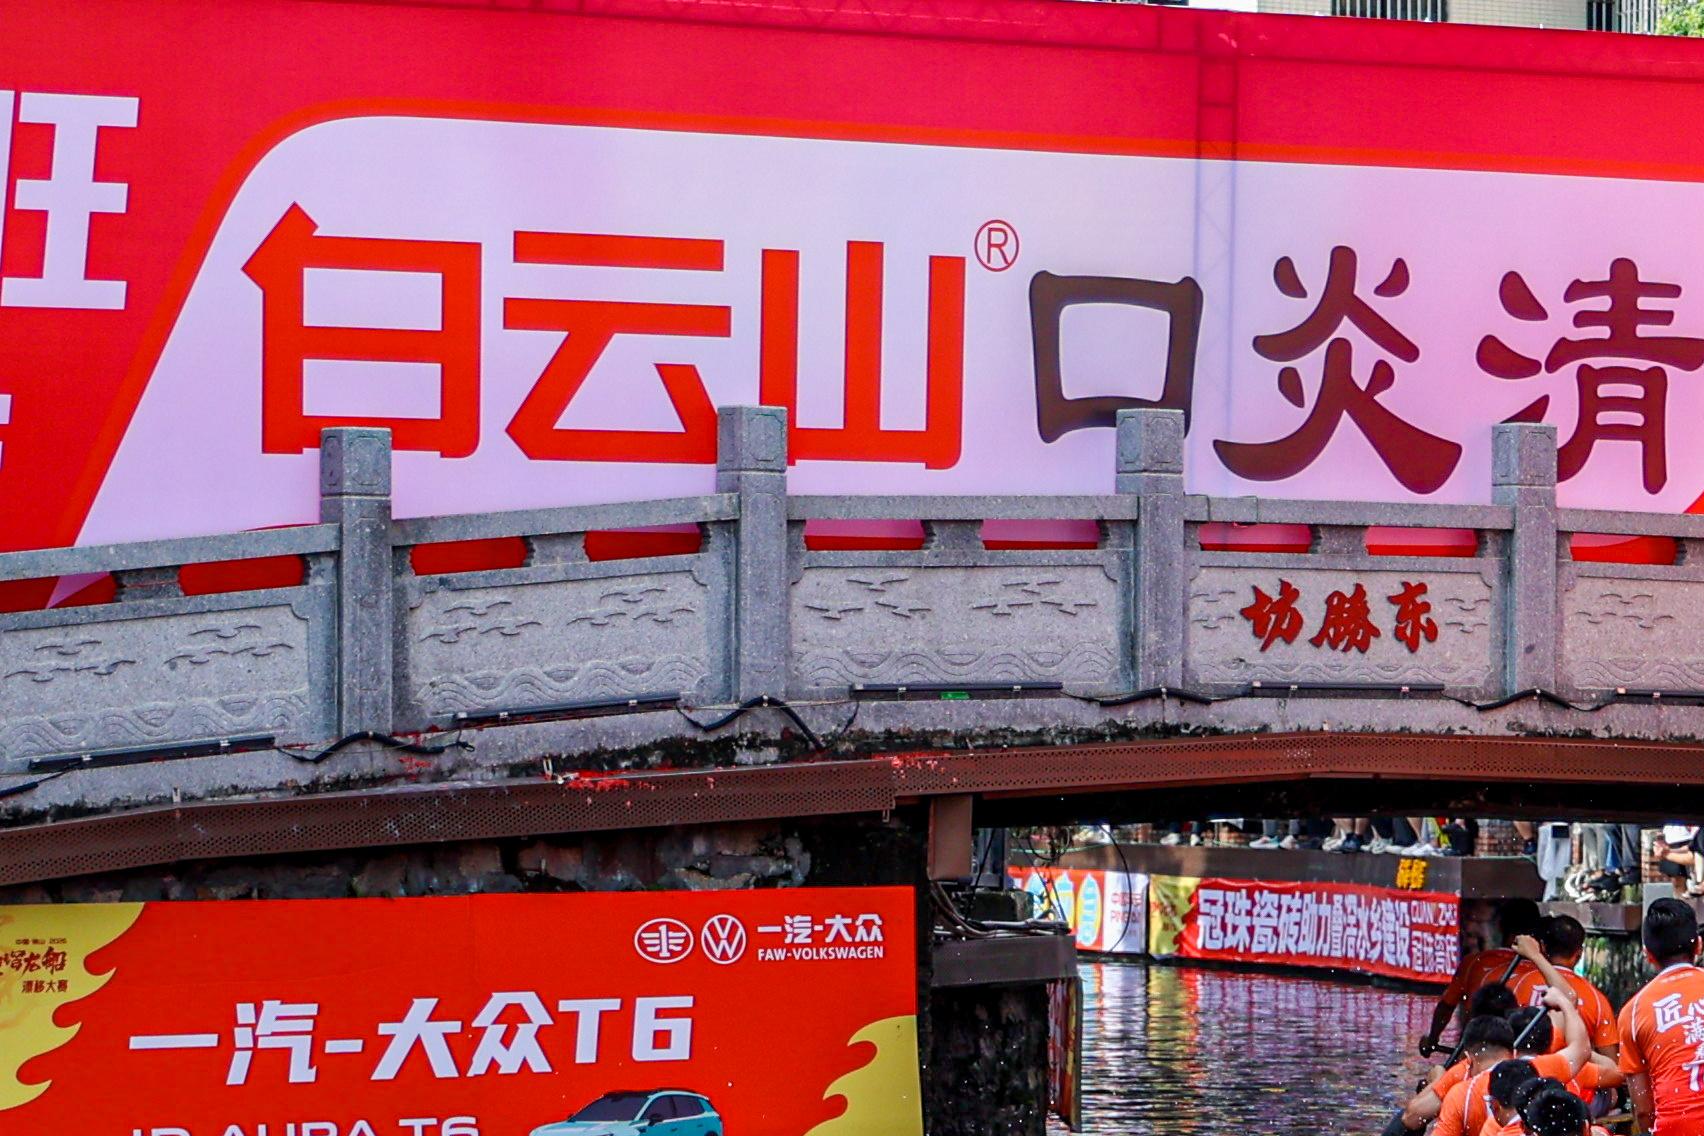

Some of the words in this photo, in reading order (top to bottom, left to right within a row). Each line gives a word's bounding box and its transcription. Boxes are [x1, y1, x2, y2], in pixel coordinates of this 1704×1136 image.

[241, 202, 966, 471] 白云山
[757, 913, 884, 944] 一汽-大众
[757, 945, 884, 961] FAW-VOLKSWAGEN
